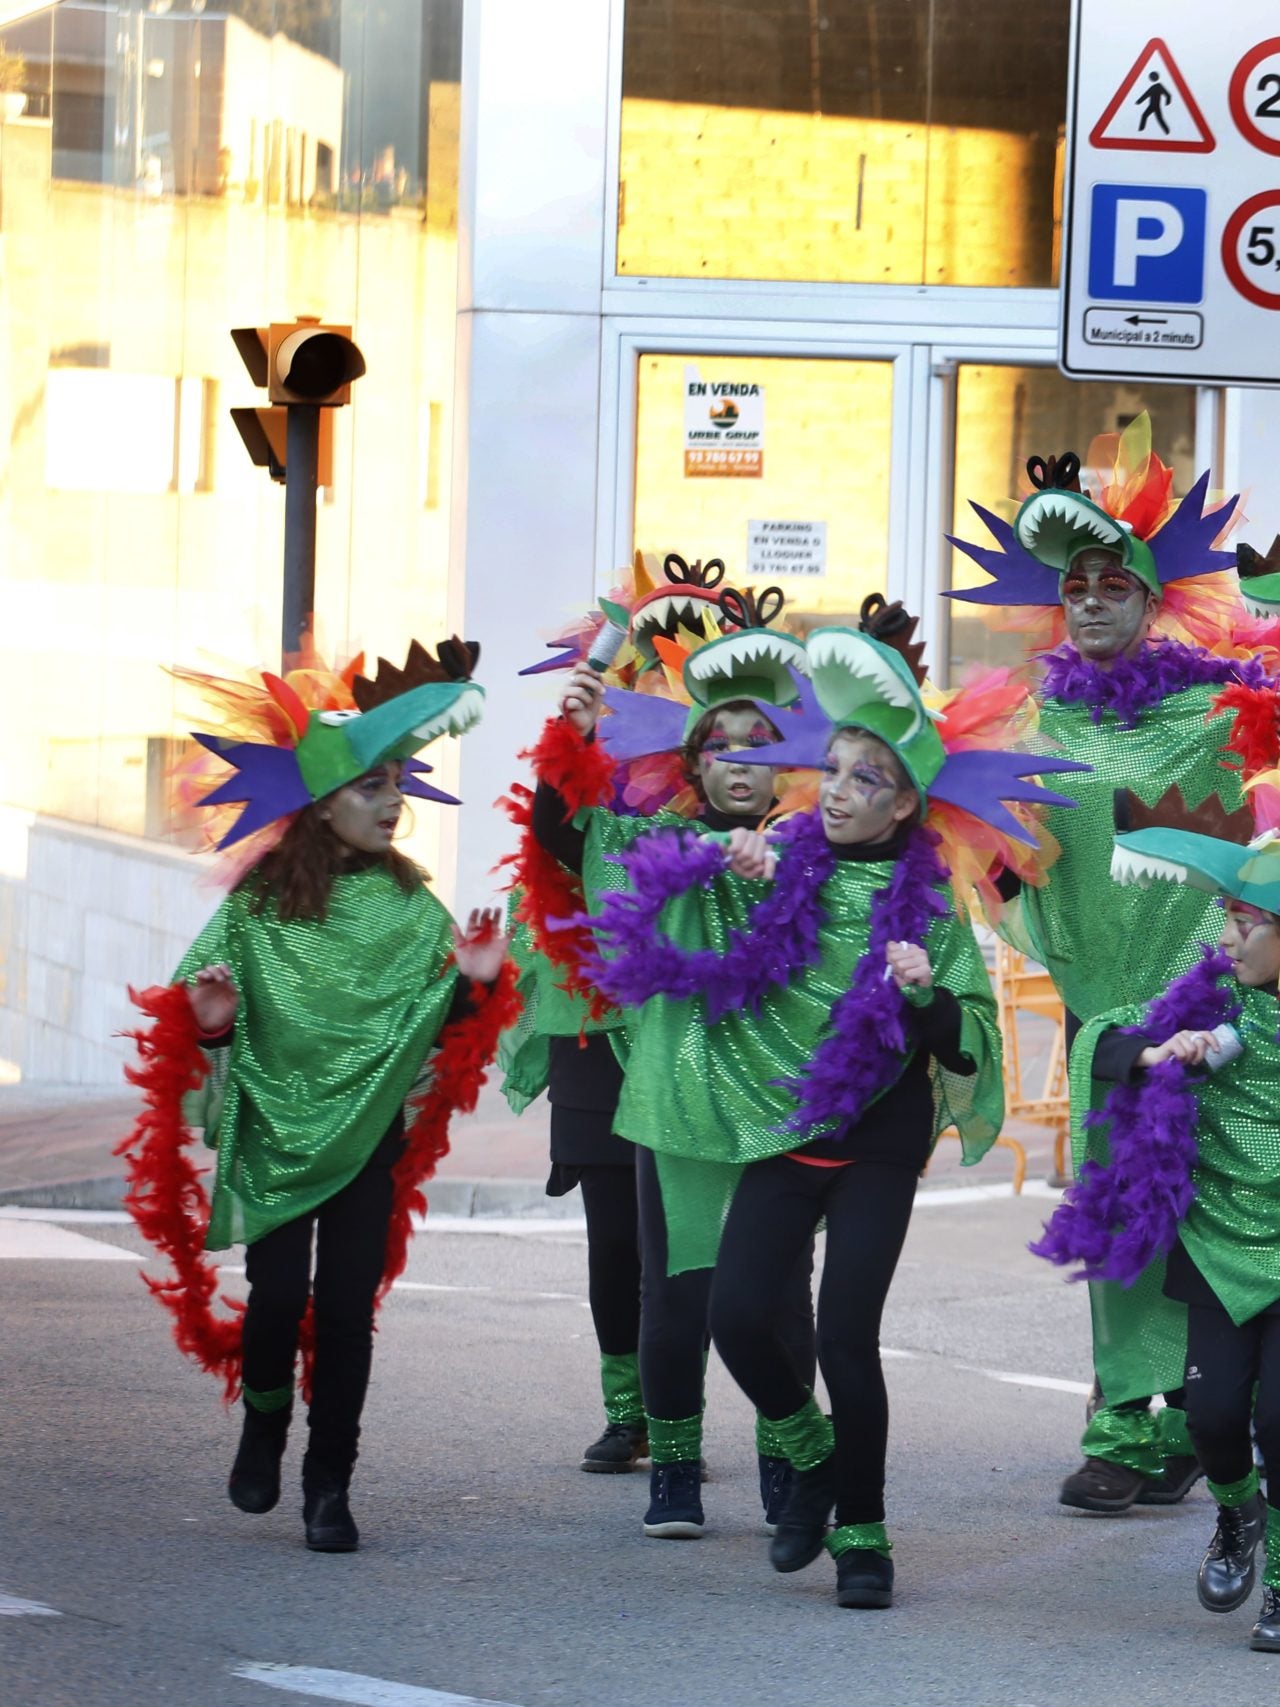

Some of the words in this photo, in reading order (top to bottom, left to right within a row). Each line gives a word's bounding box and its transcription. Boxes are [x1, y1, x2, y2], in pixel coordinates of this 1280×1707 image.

[1112, 198, 1185, 287] P
[1091, 328, 1143, 344] Municipal
[1144, 333, 1152, 343] a
[1153, 331, 1160, 343] 2
[688, 382, 707, 396] EN
[711, 382, 760, 397] VENDA
[763, 523, 813, 533] PARKING
